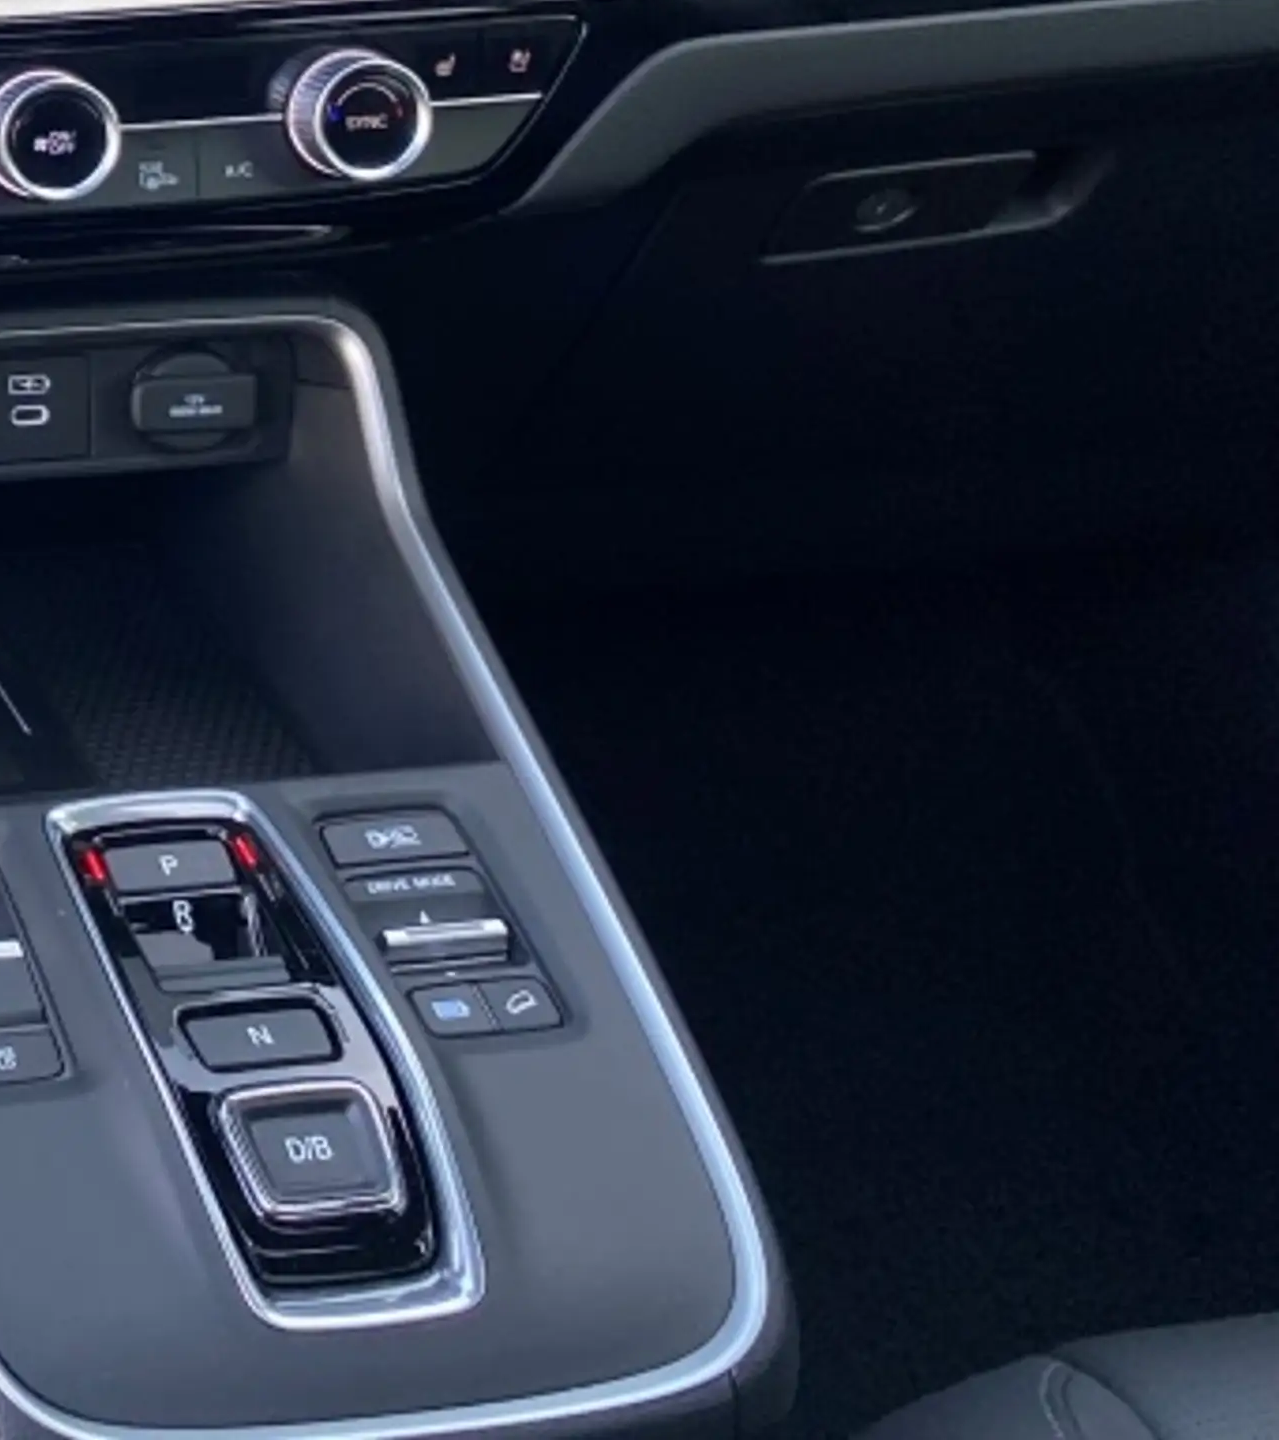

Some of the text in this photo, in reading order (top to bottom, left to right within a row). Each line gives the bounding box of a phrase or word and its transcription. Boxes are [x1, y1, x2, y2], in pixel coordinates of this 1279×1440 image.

[158, 854, 179, 877] P
[367, 872, 457, 894] DRIVE MODE
[246, 1023, 275, 1047] N
[284, 1134, 334, 1164] D/B
